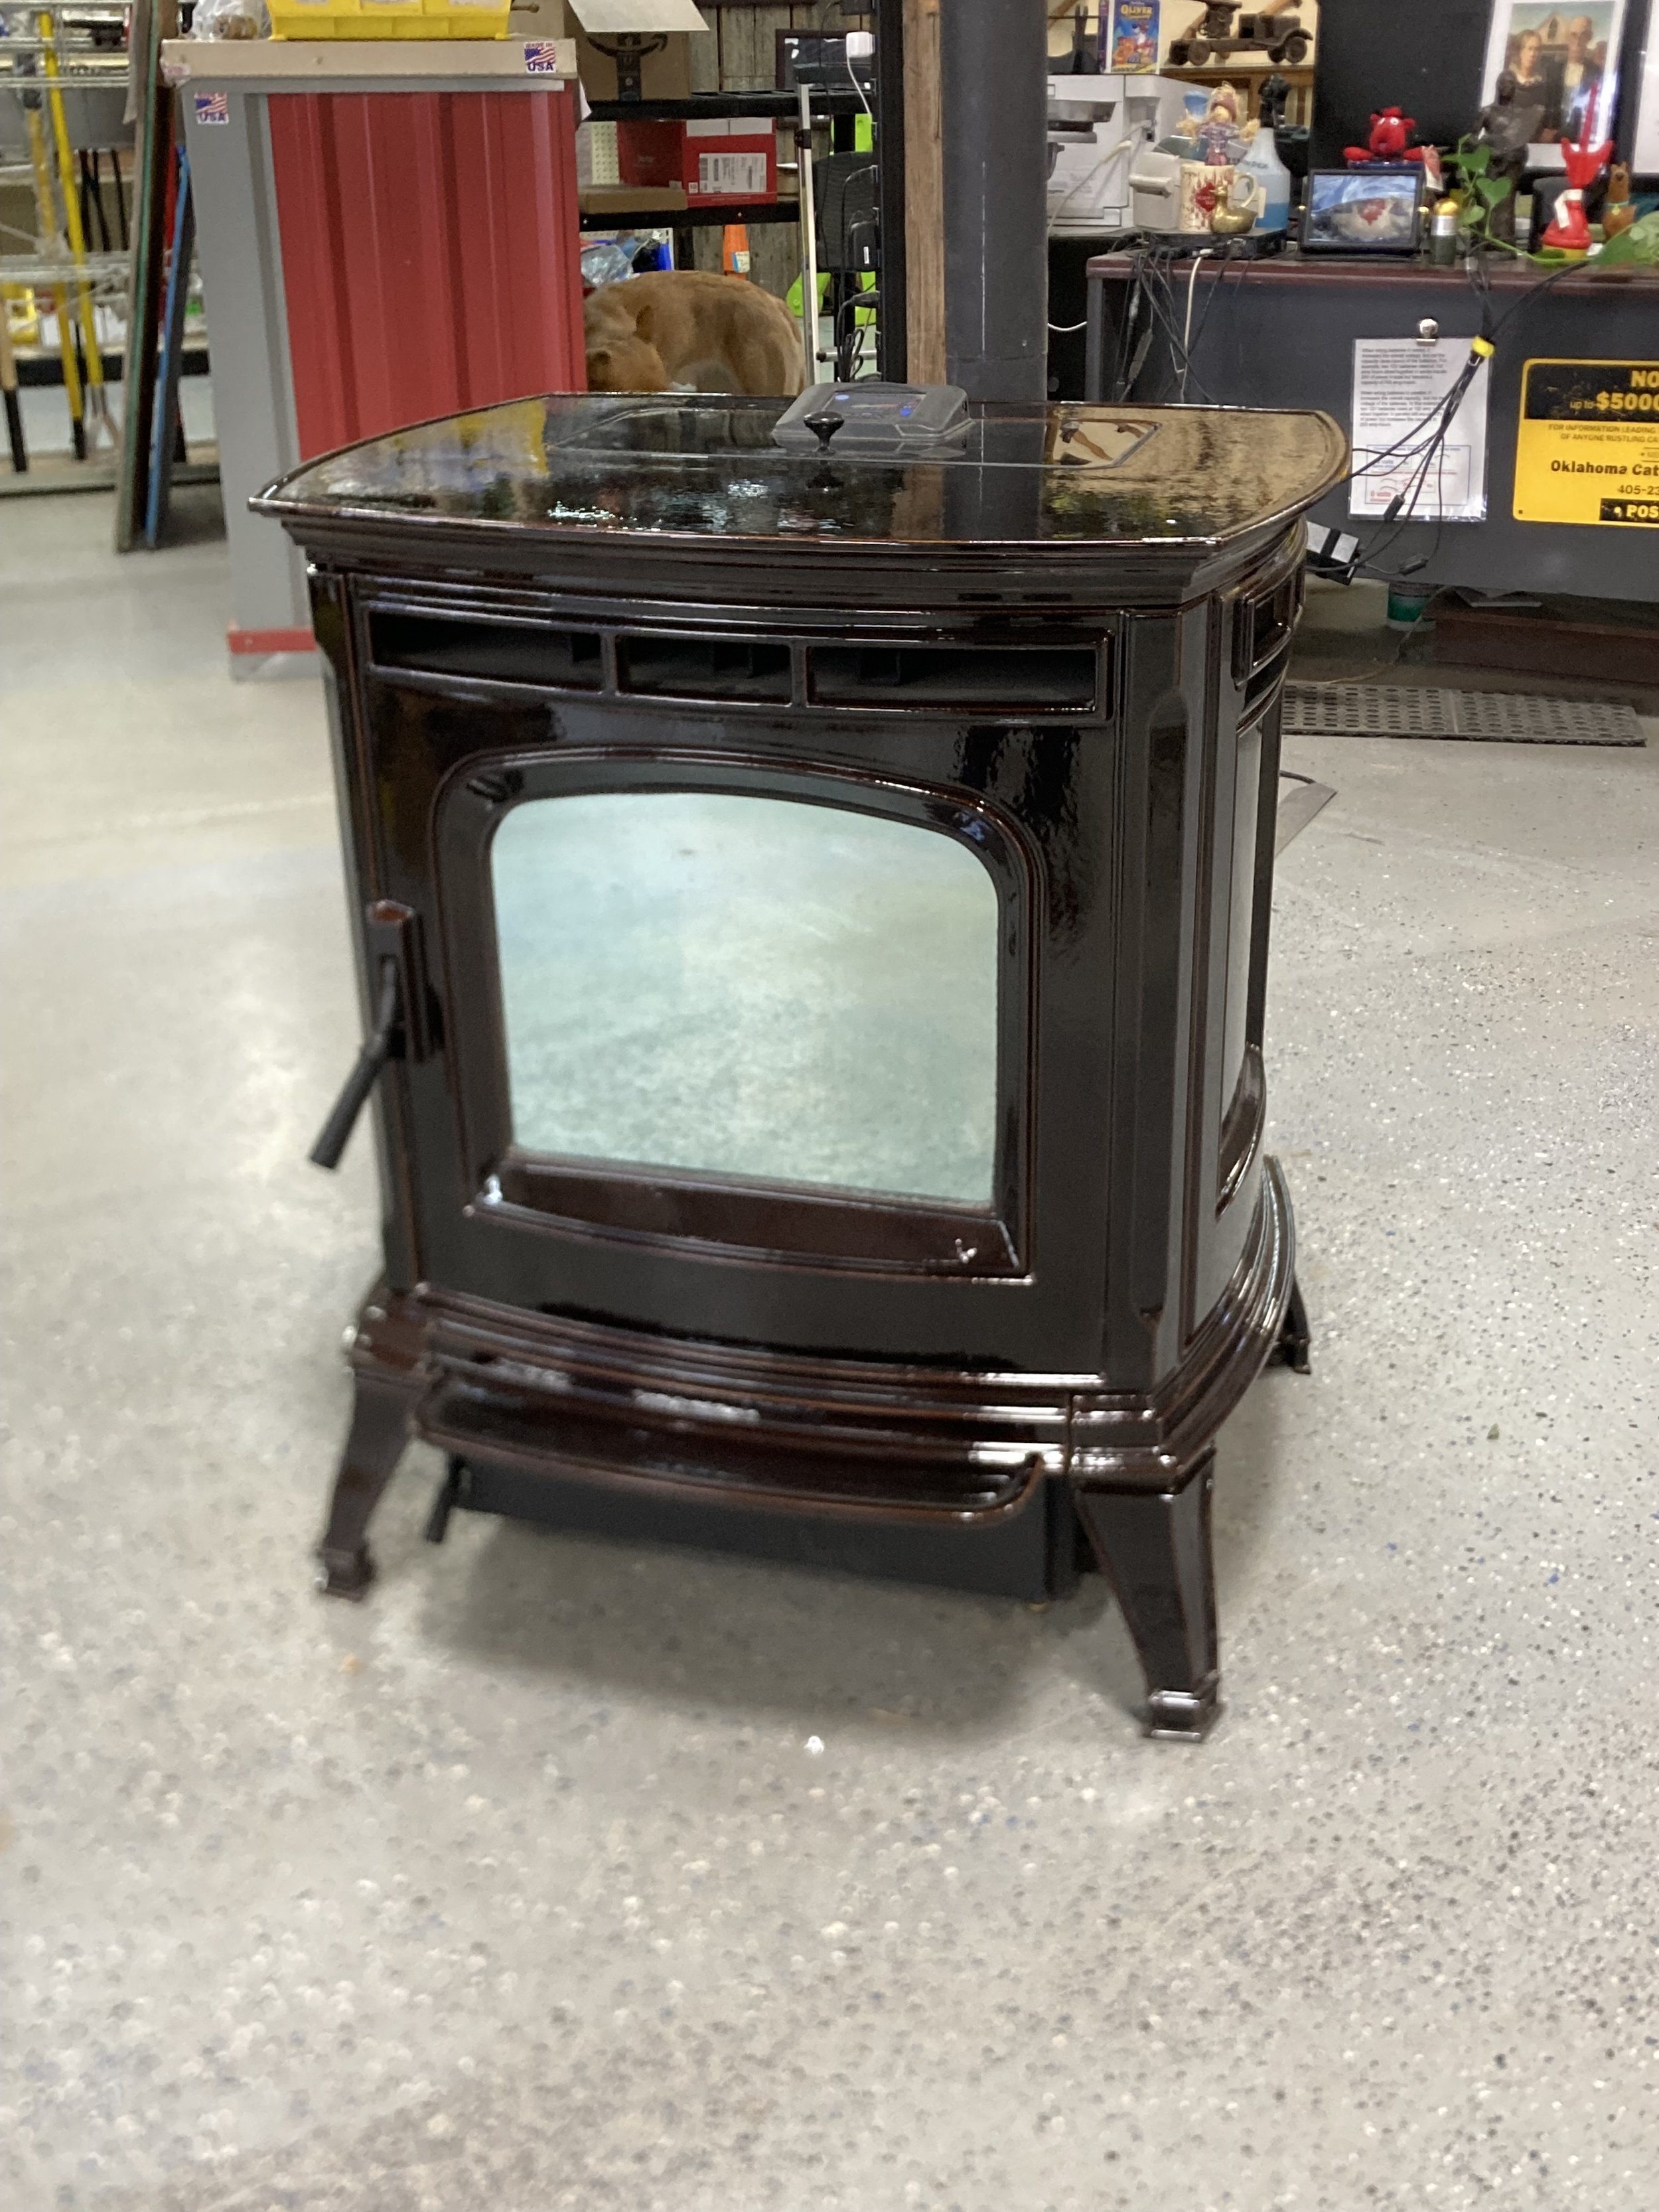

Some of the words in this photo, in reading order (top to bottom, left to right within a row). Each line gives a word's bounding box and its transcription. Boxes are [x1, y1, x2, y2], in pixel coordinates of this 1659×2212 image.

[528, 62, 553, 71] USA
[1631, 370, 1659, 387] NO
[1584, 400, 1593, 409] to
[1565, 424, 1620, 433] INFORMATION
[1551, 460, 1627, 475] Oklahoma
[1632, 463, 1659, 476] Cat
[1626, 504, 1659, 518] POS
